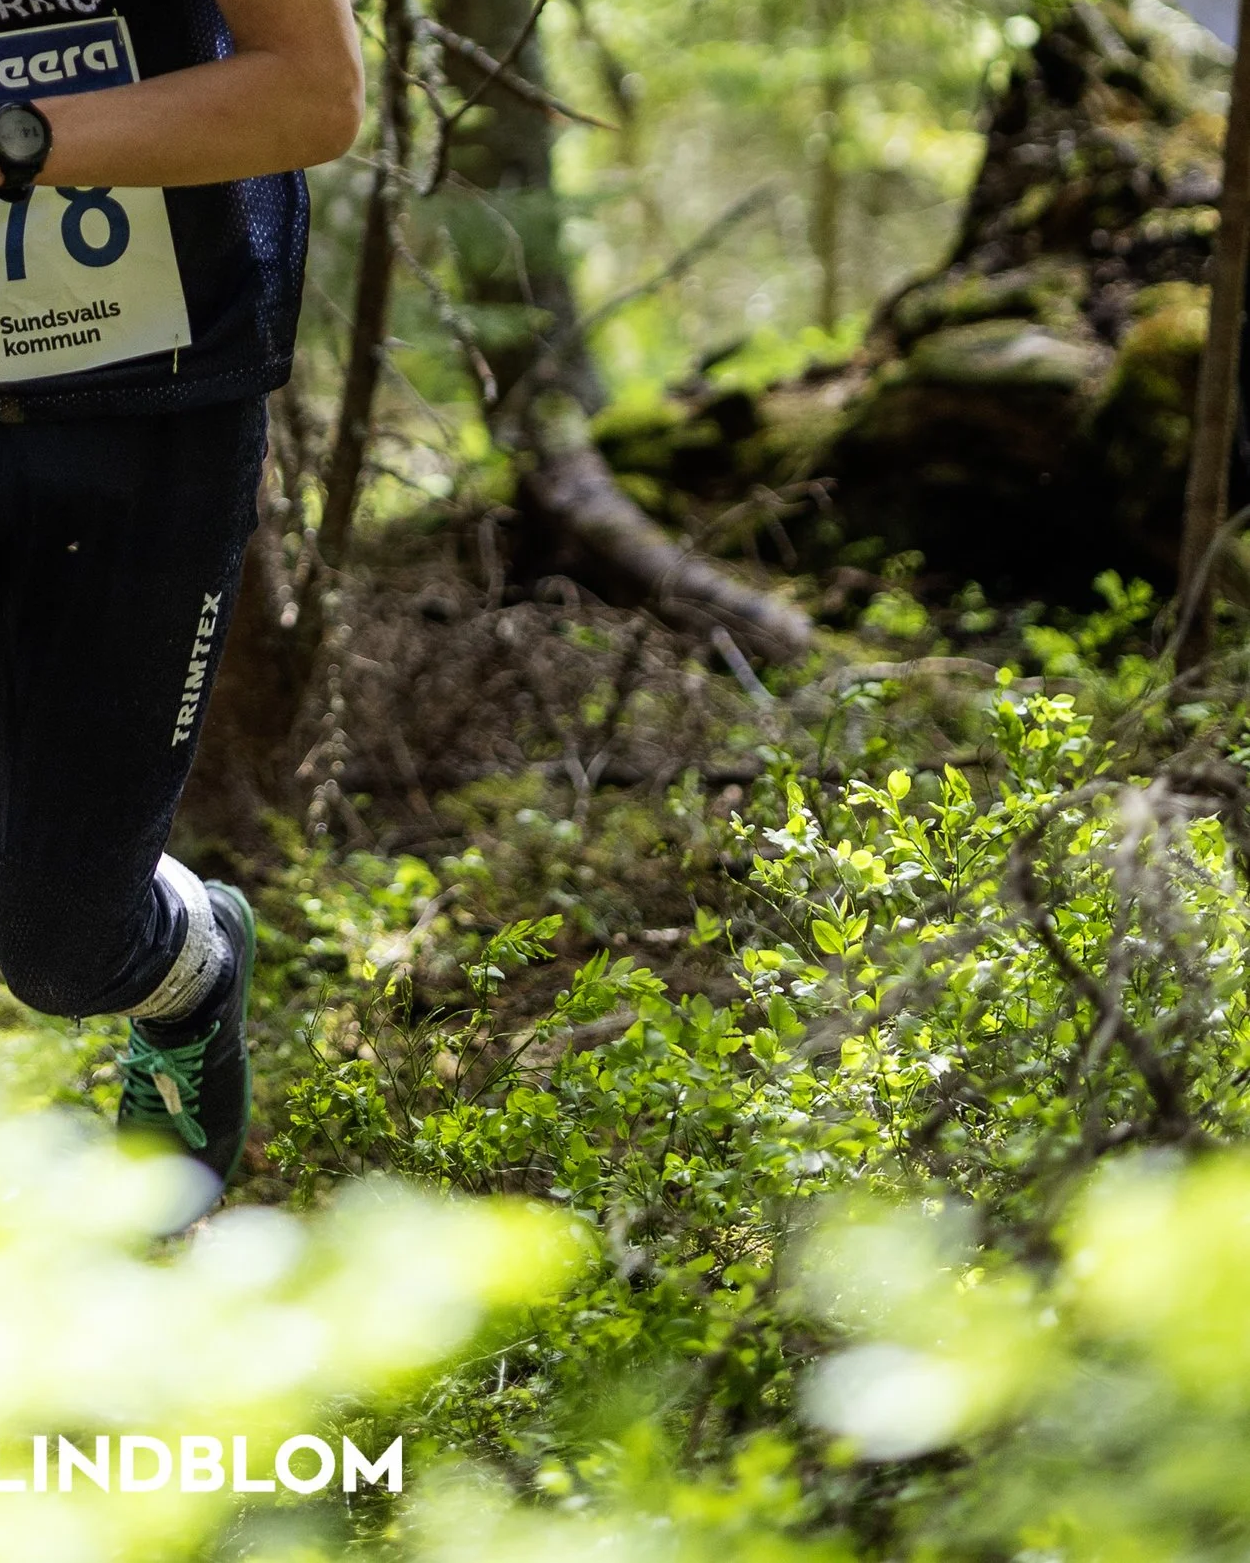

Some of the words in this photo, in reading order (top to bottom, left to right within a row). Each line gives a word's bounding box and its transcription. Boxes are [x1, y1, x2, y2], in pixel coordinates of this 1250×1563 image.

[0, 300, 121, 335] Sundsvalls
[3, 326, 101, 357] kommun
[172, 591, 222, 747] TRIMTEX
